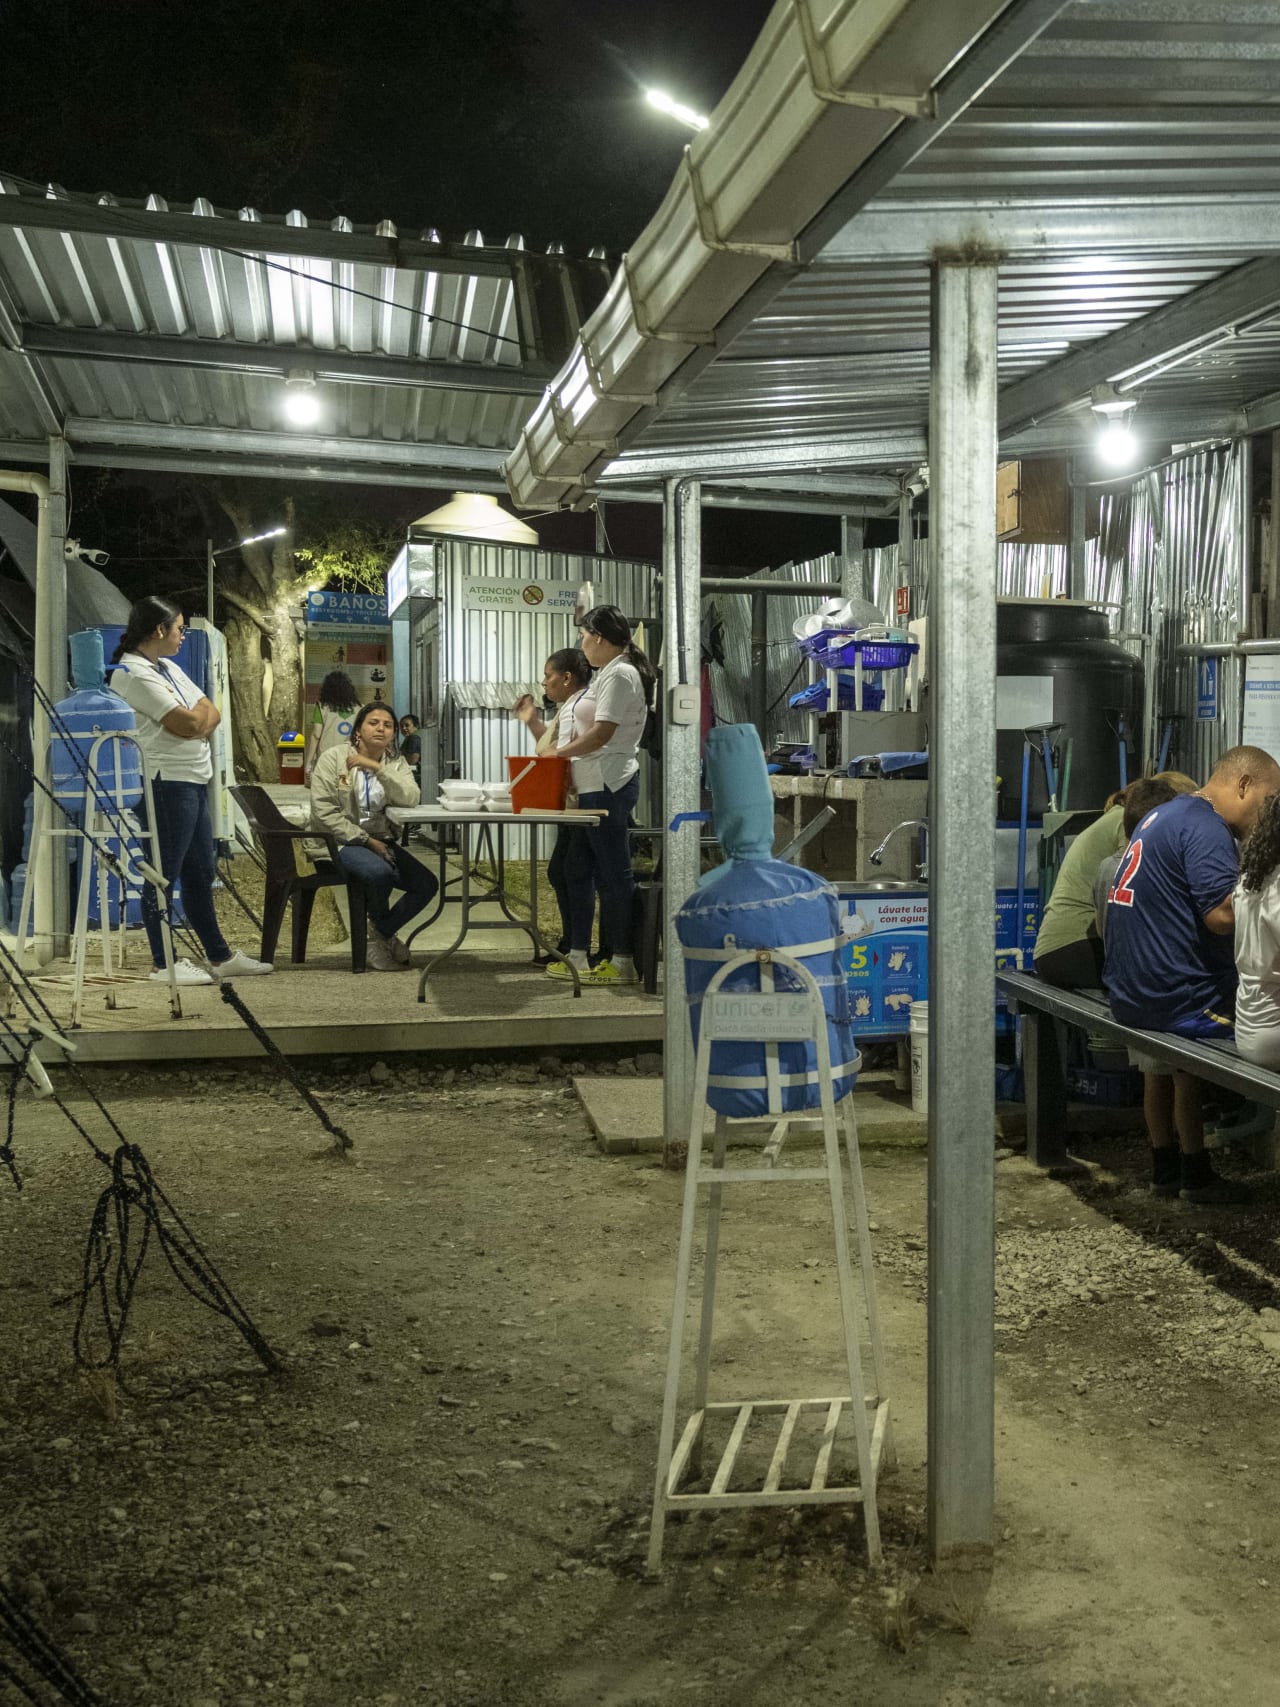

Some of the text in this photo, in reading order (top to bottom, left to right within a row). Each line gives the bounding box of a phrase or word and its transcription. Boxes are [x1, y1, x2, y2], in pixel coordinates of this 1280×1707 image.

[469, 586, 520, 595] ATENCIÓN
[329, 595, 387, 611] BAÑOS
[478, 595, 514, 604] GRATIS
[878, 905, 911, 914] Lávate
[900, 916, 925, 924] agua
[850, 945, 868, 969] 5
